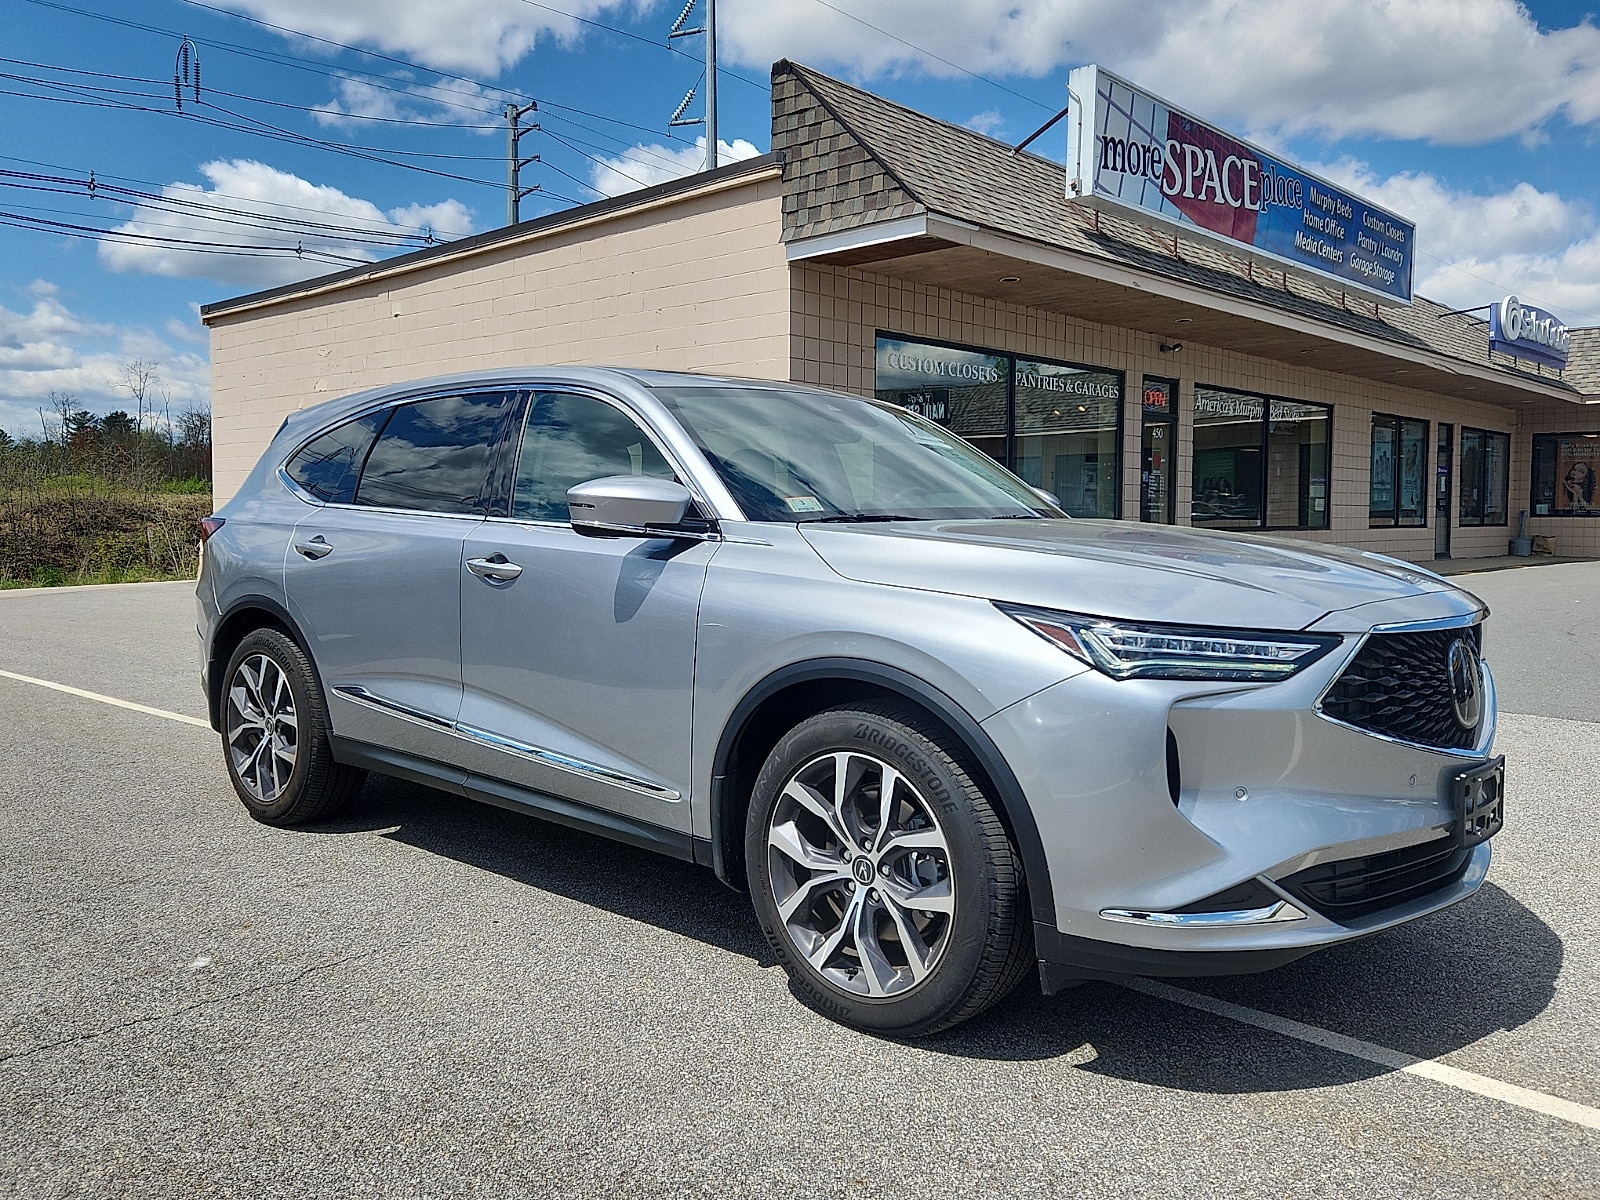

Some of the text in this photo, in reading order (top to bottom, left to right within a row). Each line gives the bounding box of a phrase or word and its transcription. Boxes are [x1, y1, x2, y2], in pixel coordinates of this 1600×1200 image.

[1309, 186, 1353, 219] Murphy Beds
[1303, 208, 1345, 239] Home Office
[1363, 211, 1405, 243] Custom Closets
[1294, 230, 1344, 263] Media Centers
[1358, 231, 1378, 256] Pantry
[1381, 241, 1404, 268] Laundry
[1350, 252, 1395, 285] Garage Storage
[887, 353, 998, 382] CUSTOM CLOSETS
[1015, 371, 1119, 399] PANTRIES & GARAGES
[1144, 389, 1166, 406] OPEN
[1194, 395, 1234, 415] America's
[1235, 400, 1264, 421] Murphy
[1269, 404, 1283, 419] Bed
[1152, 427, 1163, 439] 450
[253, 636, 294, 674] BRIDGESTONE
[854, 723, 959, 814] BRIDGESTONE
